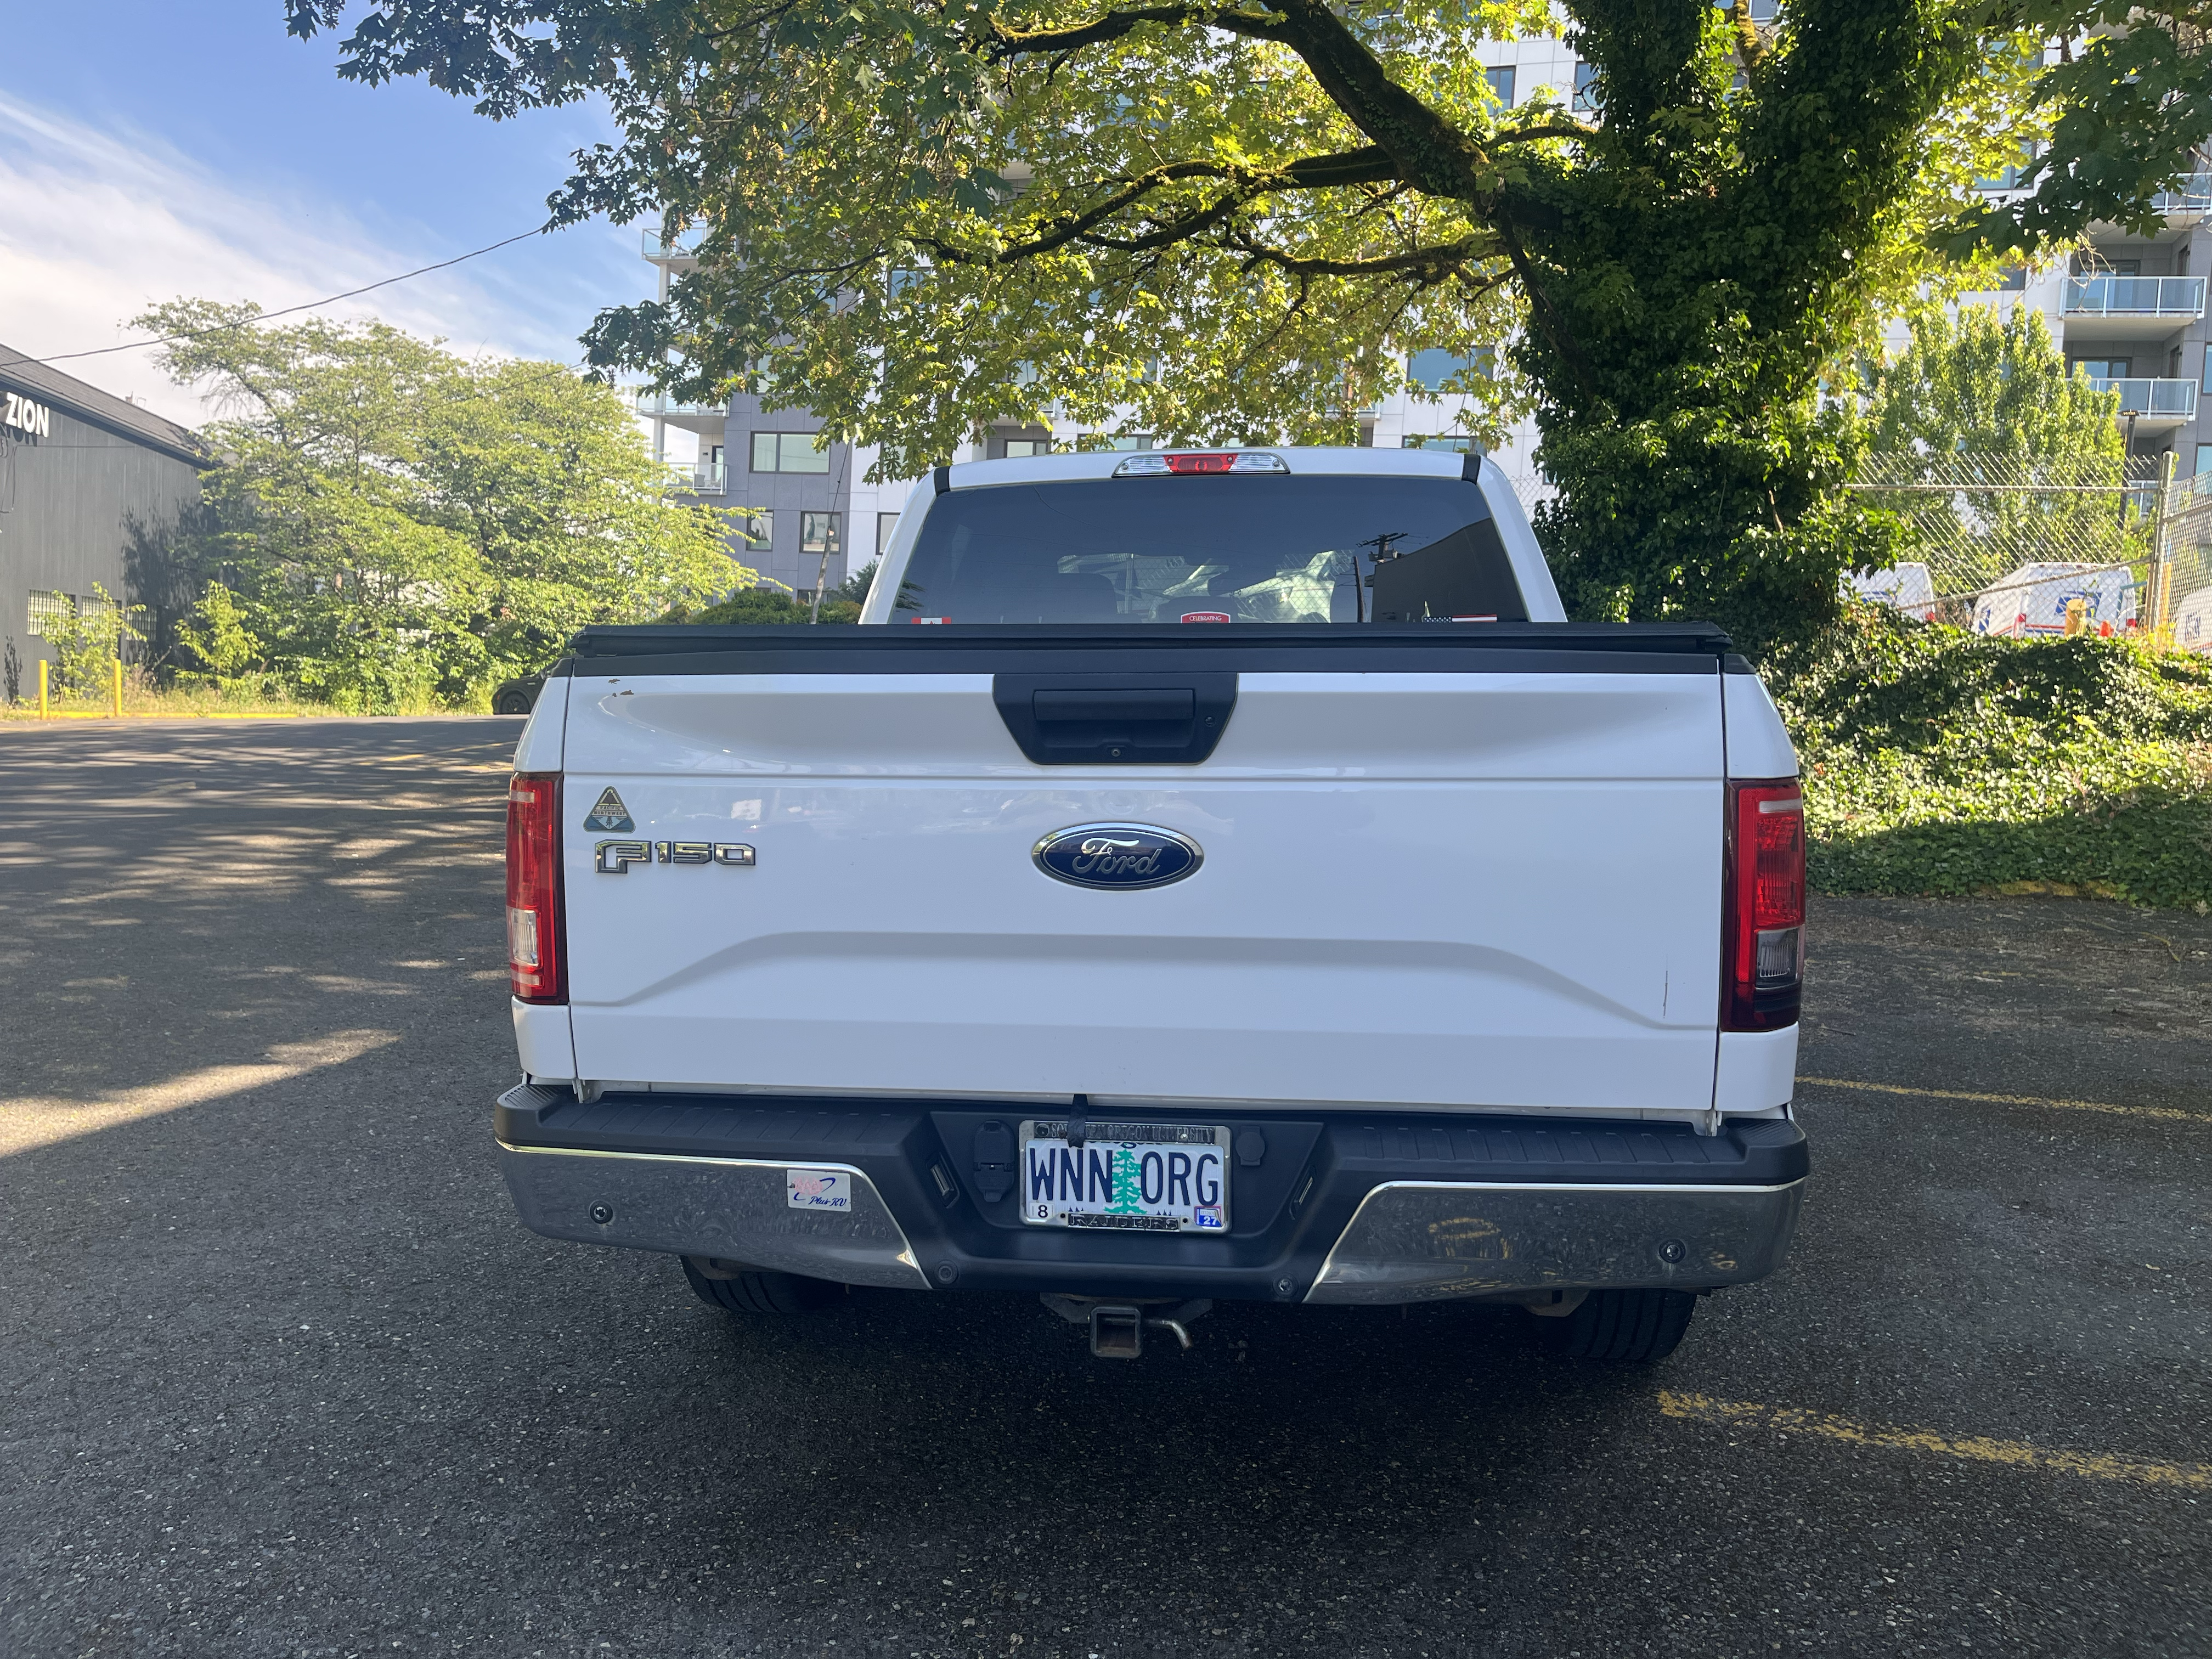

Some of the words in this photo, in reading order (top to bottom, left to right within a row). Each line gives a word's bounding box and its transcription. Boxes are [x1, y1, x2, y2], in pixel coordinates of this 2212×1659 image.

[5, 392, 49, 438] ZION
[1072, 837, 1163, 875] Ford
[1030, 1147, 1113, 1203] WNN
[1140, 1151, 1219, 1206] ORG
[808, 1196, 831, 1205] Plus
[830, 1198, 847, 1206] RV
[1037, 1204, 1048, 1218] 8
[1070, 1213, 1178, 1230] RAIDERS
[1203, 1216, 1217, 1226] 27
